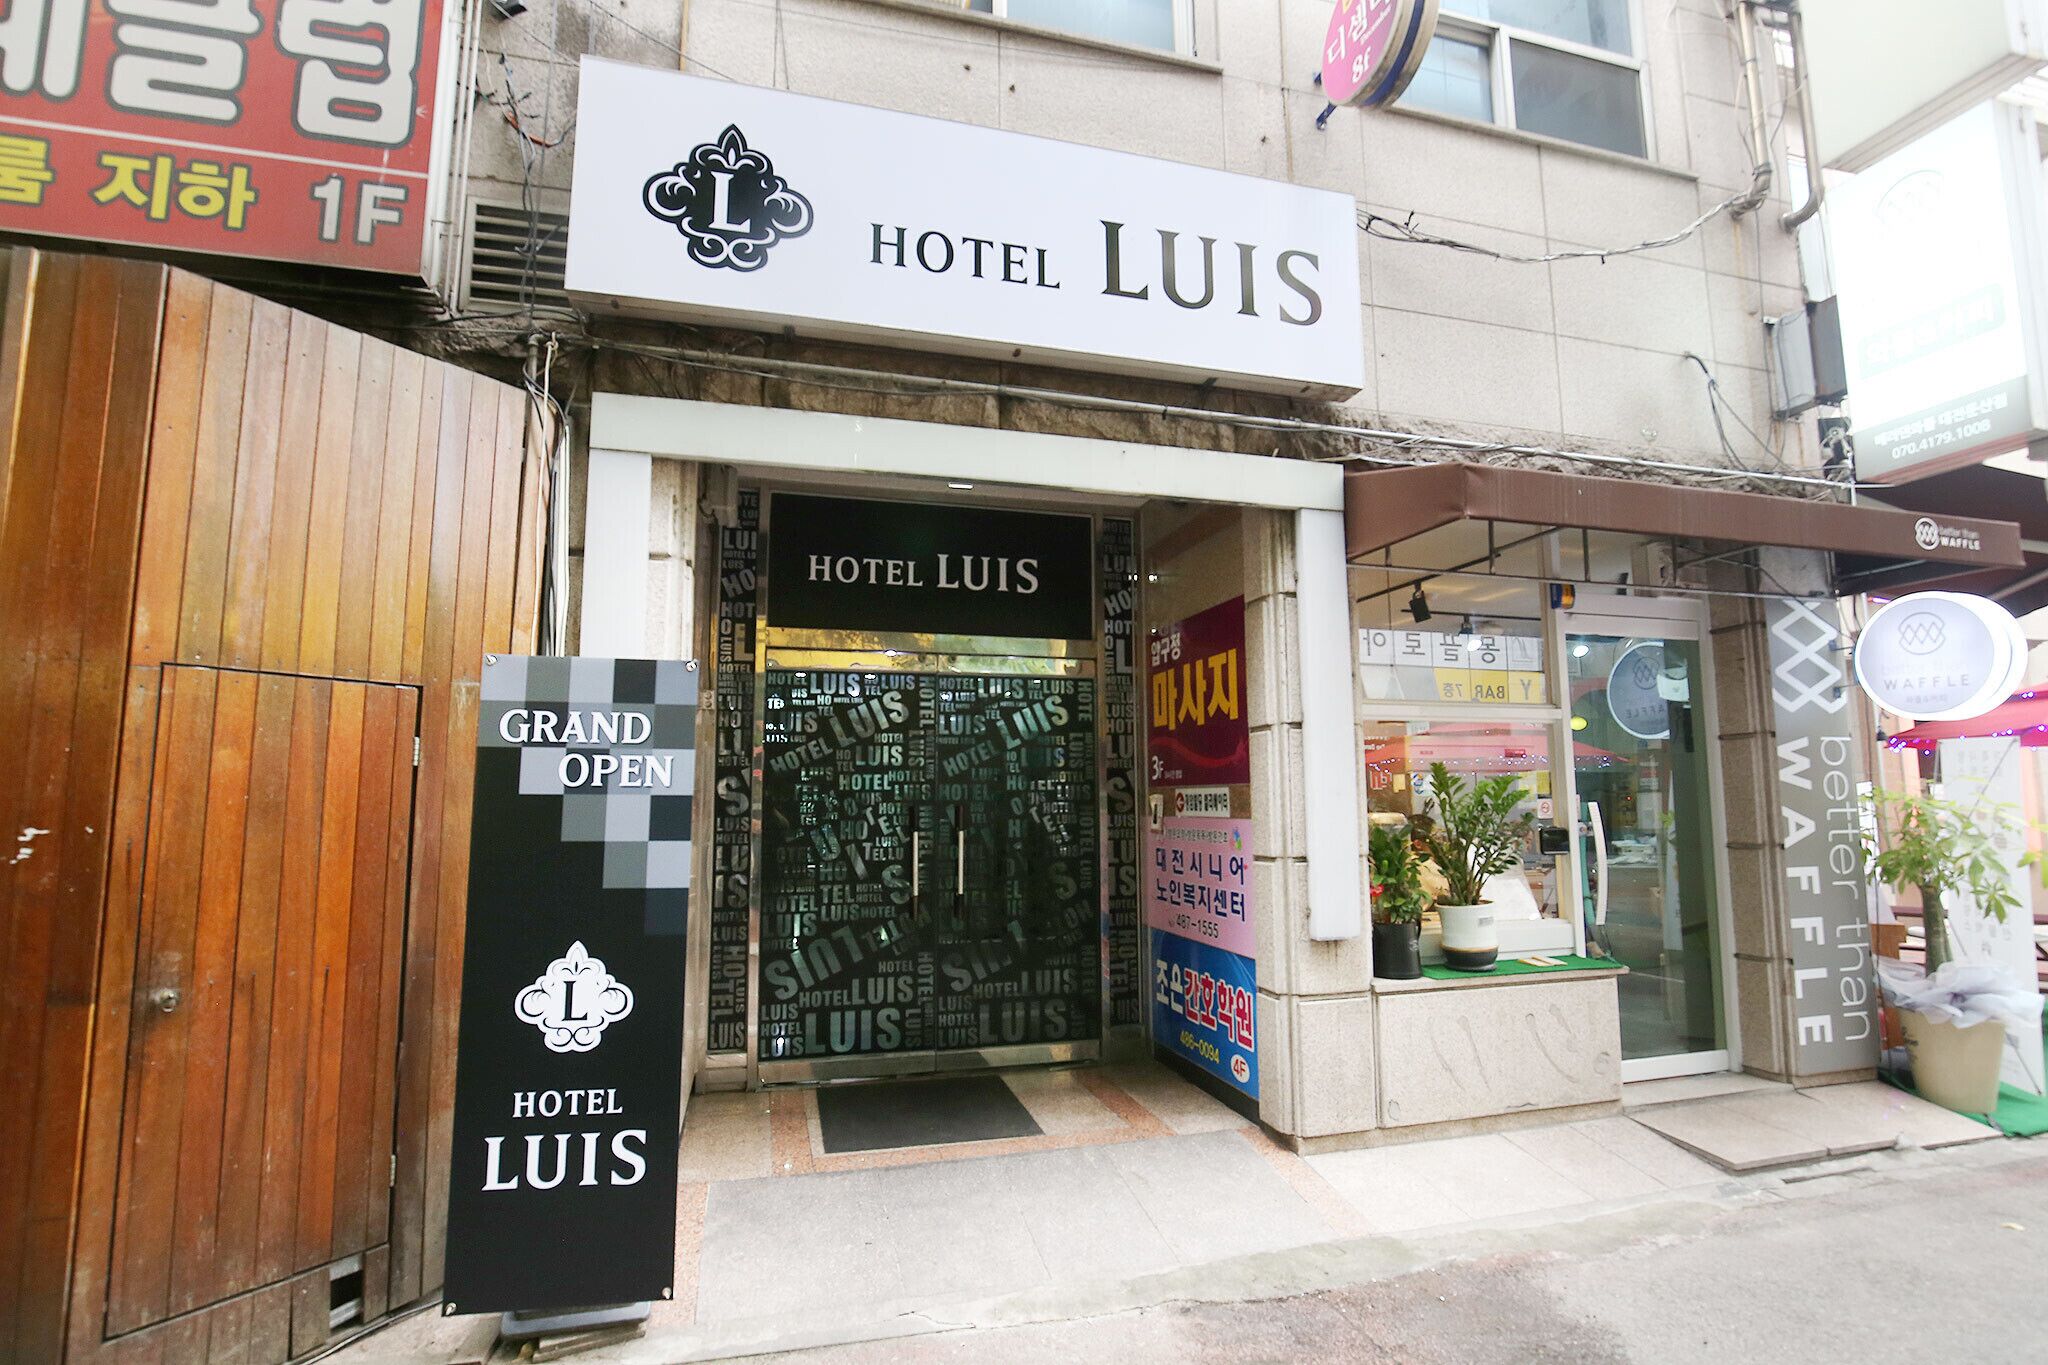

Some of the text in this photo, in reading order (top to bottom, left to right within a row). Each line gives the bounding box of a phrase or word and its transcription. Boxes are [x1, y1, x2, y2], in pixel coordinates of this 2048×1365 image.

[93, 152, 258, 231] 지하
[311, 173, 409, 245] 1F
[870, 219, 1323, 327] HOTEL LUIS
[1940, 536, 1981, 551] WAFFLE
[808, 552, 1040, 595] HOTEL LUIS
[1151, 632, 1181, 668] 압구정
[810, 672, 860, 697] LUIS
[881, 674, 916, 690] LUIS
[939, 678, 976, 690] HOTEL
[978, 678, 1024, 699] LUIS
[1043, 680, 1075, 695] LUIS
[1152, 648, 1239, 731] 마사지
[1884, 673, 1971, 691] WAFFLE
[498, 707, 653, 746] GRAND
[829, 690, 909, 748] LUIS
[939, 714, 986, 736] LUIS
[996, 694, 1069, 750] LUIS
[769, 737, 834, 773] HOTEL
[855, 745, 903, 767] LUIS
[557, 752, 675, 790] OPEN
[838, 773, 892, 791] HOTEL
[1156, 877, 1245, 922] 노인복지센터
[1777, 736, 1833, 1047] WAFFLE
[1819, 736, 1872, 1042] better than
[821, 904, 860, 922] LUIS
[1176, 913, 1219, 939] 487-1555
[713, 925, 748, 942] LUIS
[878, 960, 914, 973] HOTEL
[799, 975, 914, 1009] HOTEL LUIS
[760, 1003, 799, 1021] LUIS
[938, 1012, 977, 1027] HOTEL
[978, 998, 1068, 1045] LUIS
[709, 1021, 745, 1049] LUIS
[760, 1022, 803, 1037] HOTEL
[805, 1007, 901, 1055] LUIS
[759, 1037, 804, 1058] LUIS
[1179, 1030, 1220, 1064] 486-0094
[1233, 1058, 1247, 1078] 4F
[511, 1088, 624, 1119] HOTEL
[481, 1128, 648, 1193] LUIS
